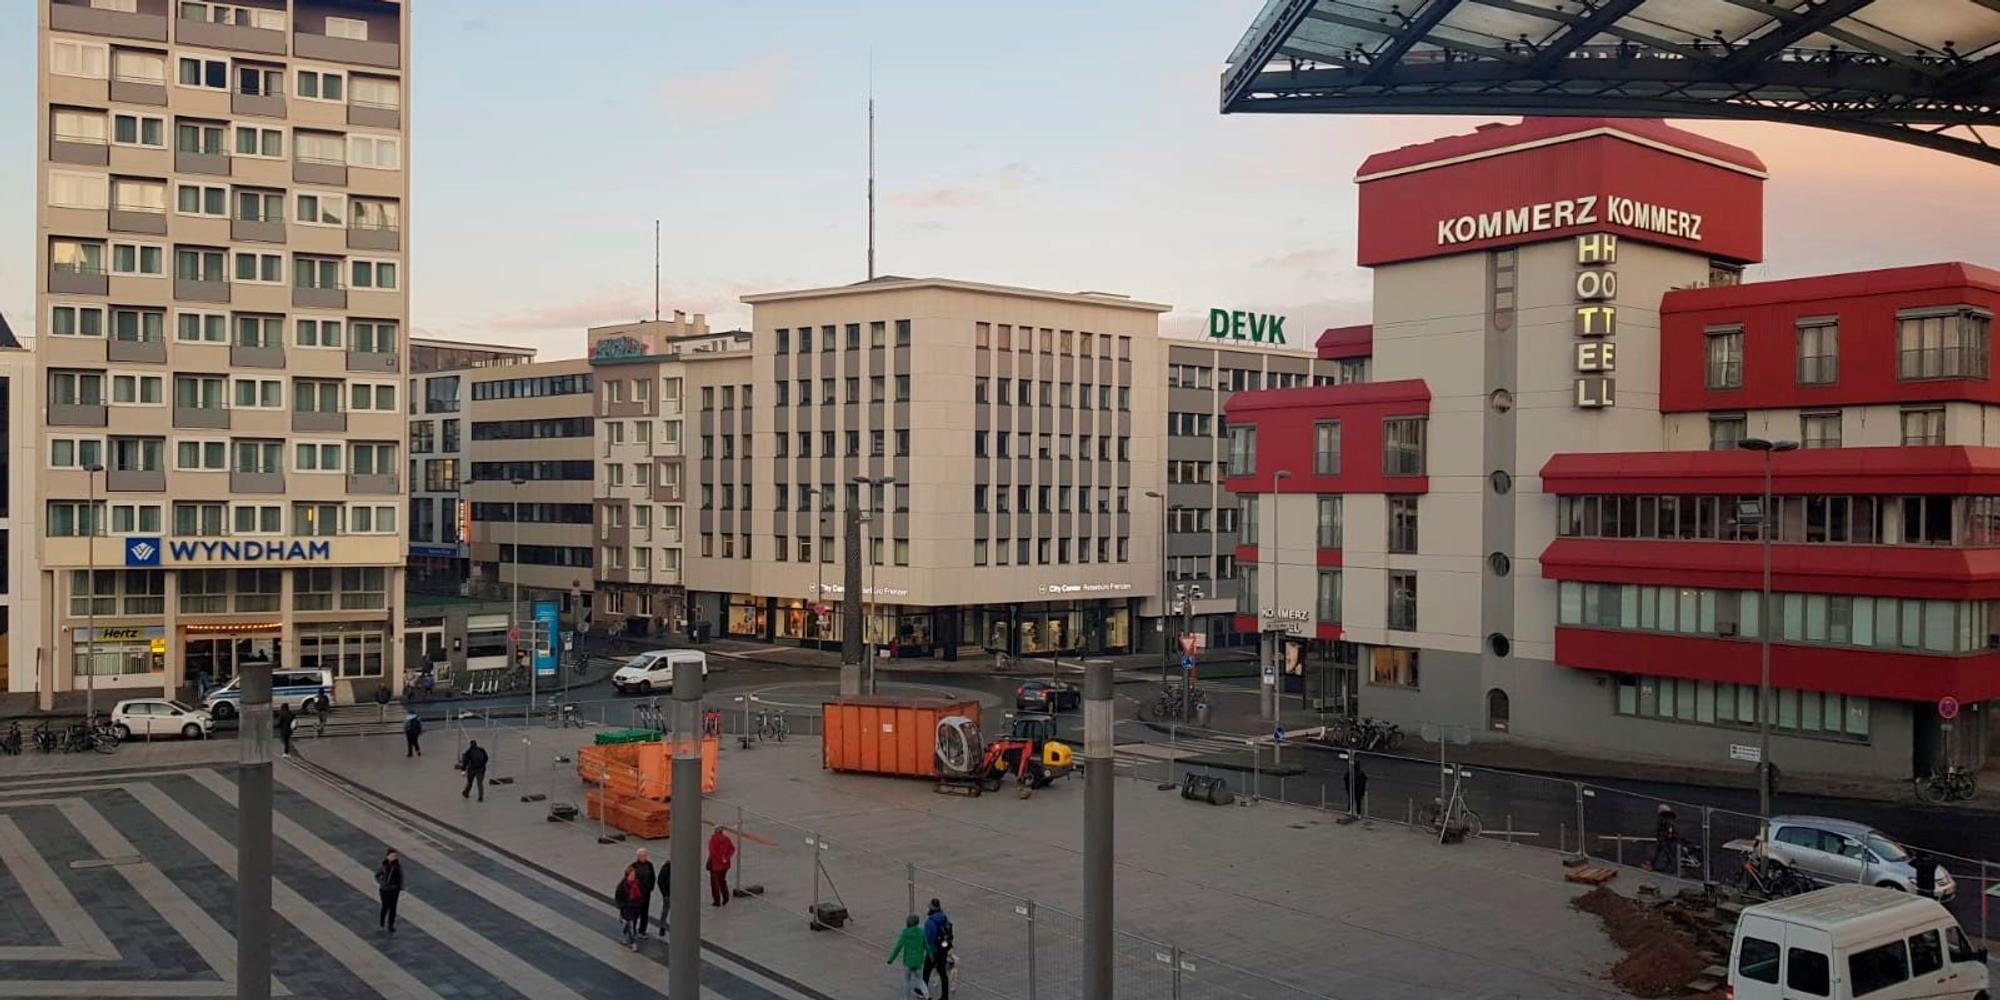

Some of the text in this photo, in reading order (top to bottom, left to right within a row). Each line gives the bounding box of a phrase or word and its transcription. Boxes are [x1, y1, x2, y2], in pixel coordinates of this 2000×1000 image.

[1437, 195, 1598, 245] KOMMERZ
[1608, 195, 1702, 241] KOMMERZ
[1209, 307, 1287, 345] DEVK
[1576, 235, 1601, 408] HOTEL
[1602, 236, 1617, 407] HOTEL
[169, 540, 330, 561] WYNDHAM
[1048, 585, 1061, 593] City
[1061, 584, 1081, 593] Center
[103, 627, 139, 639] Hertz
